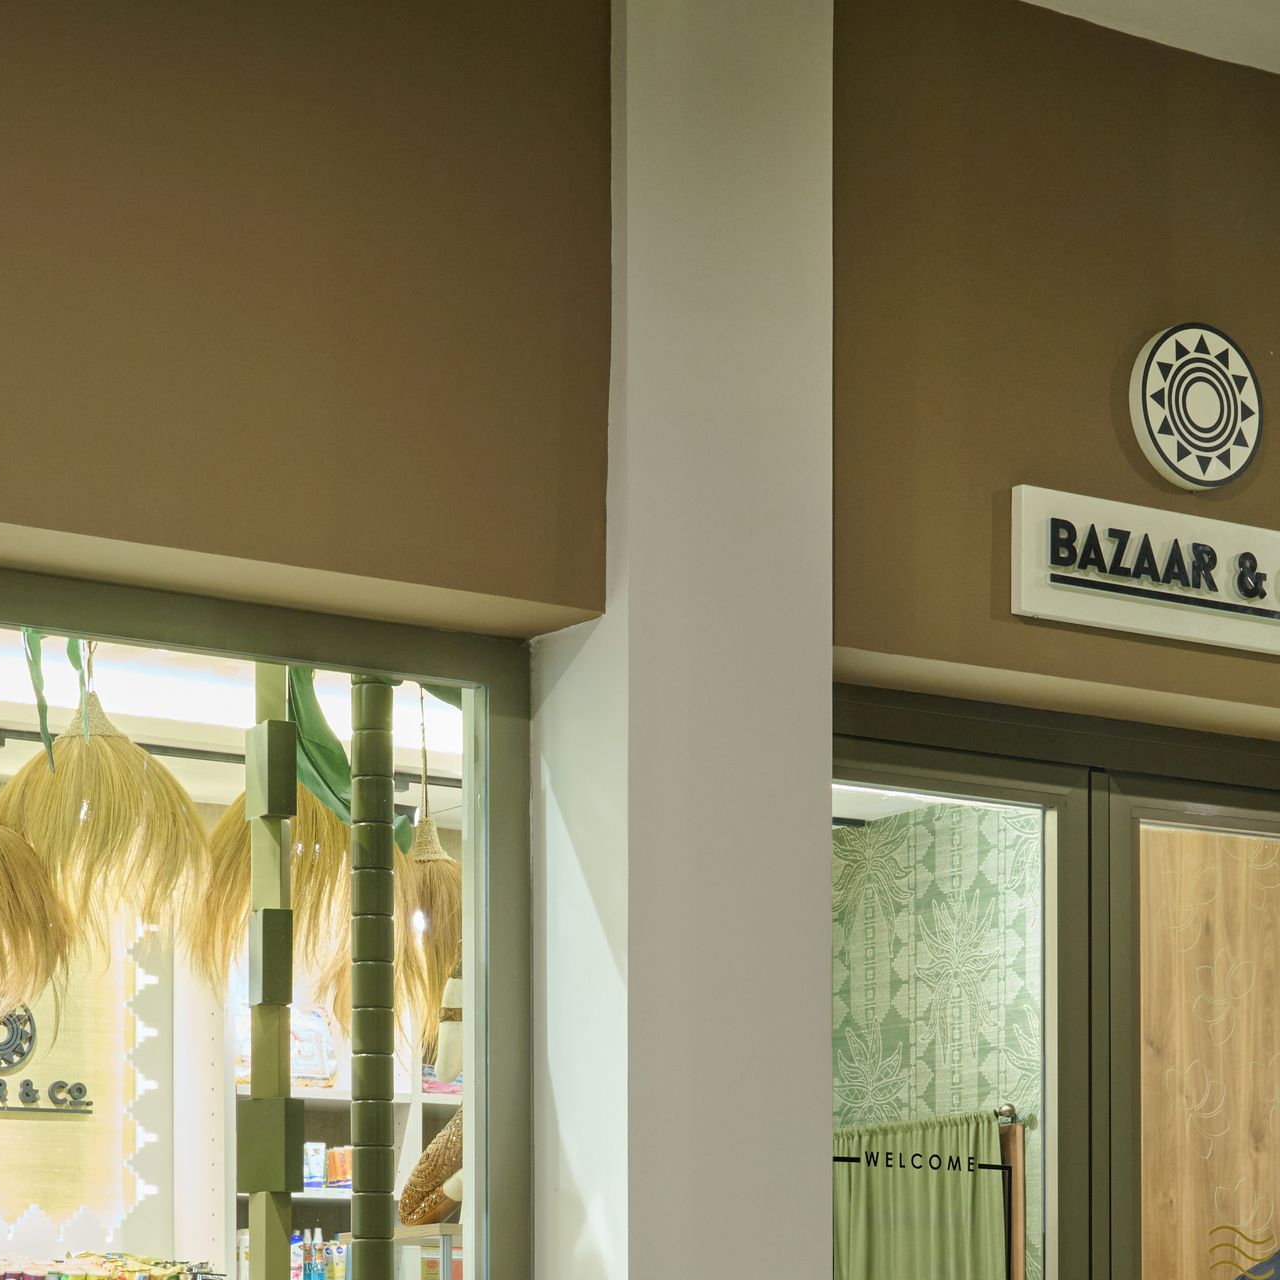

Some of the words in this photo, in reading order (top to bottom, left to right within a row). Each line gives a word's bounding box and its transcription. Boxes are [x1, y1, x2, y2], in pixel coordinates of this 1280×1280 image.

[1049, 517, 1218, 593] BAZAAR
[1235, 551, 1268, 600] &
[19, 1079, 39, 1103] &
[865, 1151, 975, 1172] WELCOME
